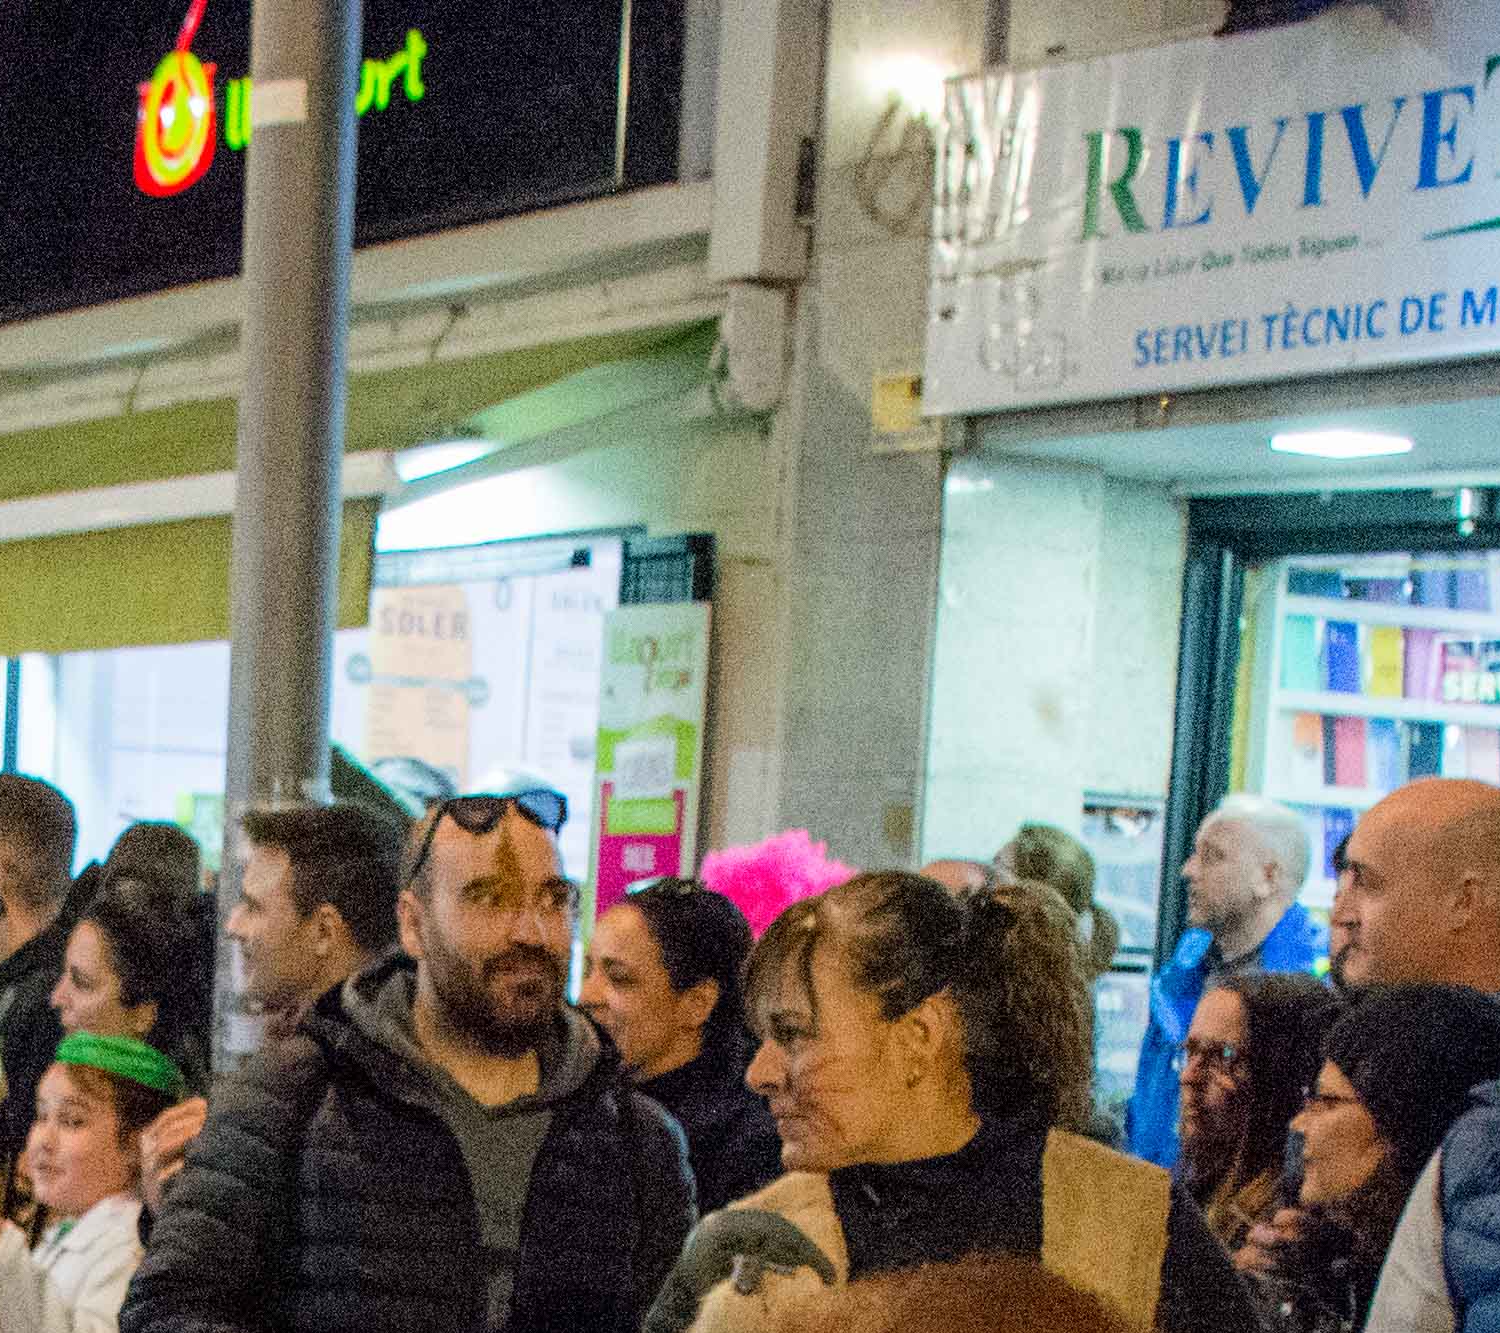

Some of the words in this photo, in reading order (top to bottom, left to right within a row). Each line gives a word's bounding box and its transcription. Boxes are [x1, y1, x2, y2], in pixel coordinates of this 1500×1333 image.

[1133, 318, 1249, 369] SERVEI
[1261, 299, 1388, 352] TÈCNIC
[1399, 292, 1448, 336] DE
